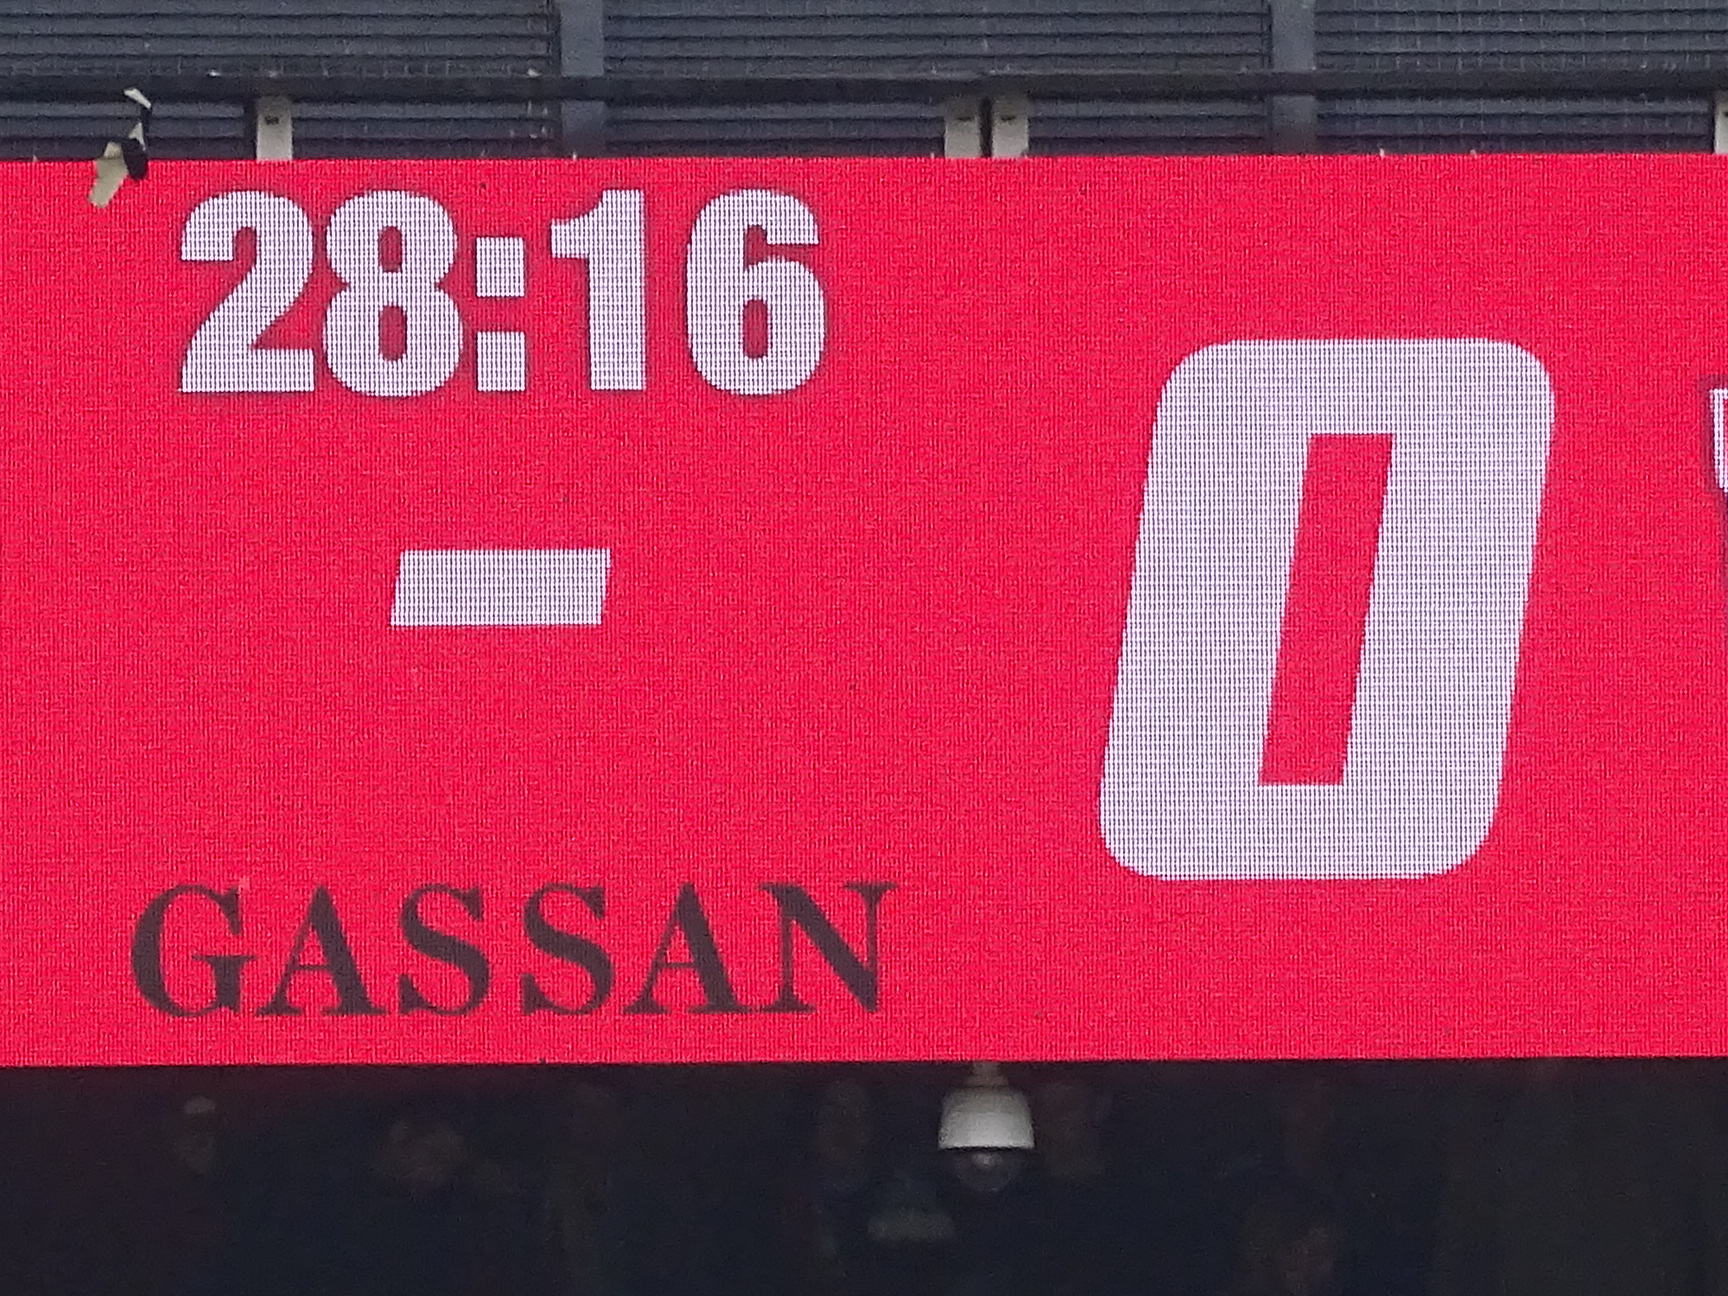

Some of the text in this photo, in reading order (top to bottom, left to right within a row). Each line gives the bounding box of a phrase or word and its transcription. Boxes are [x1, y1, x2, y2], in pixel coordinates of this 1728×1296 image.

[178, 189, 827, 397] 28:16
[1098, 338, 1556, 880] 0
[130, 881, 898, 1018] GASSAN
